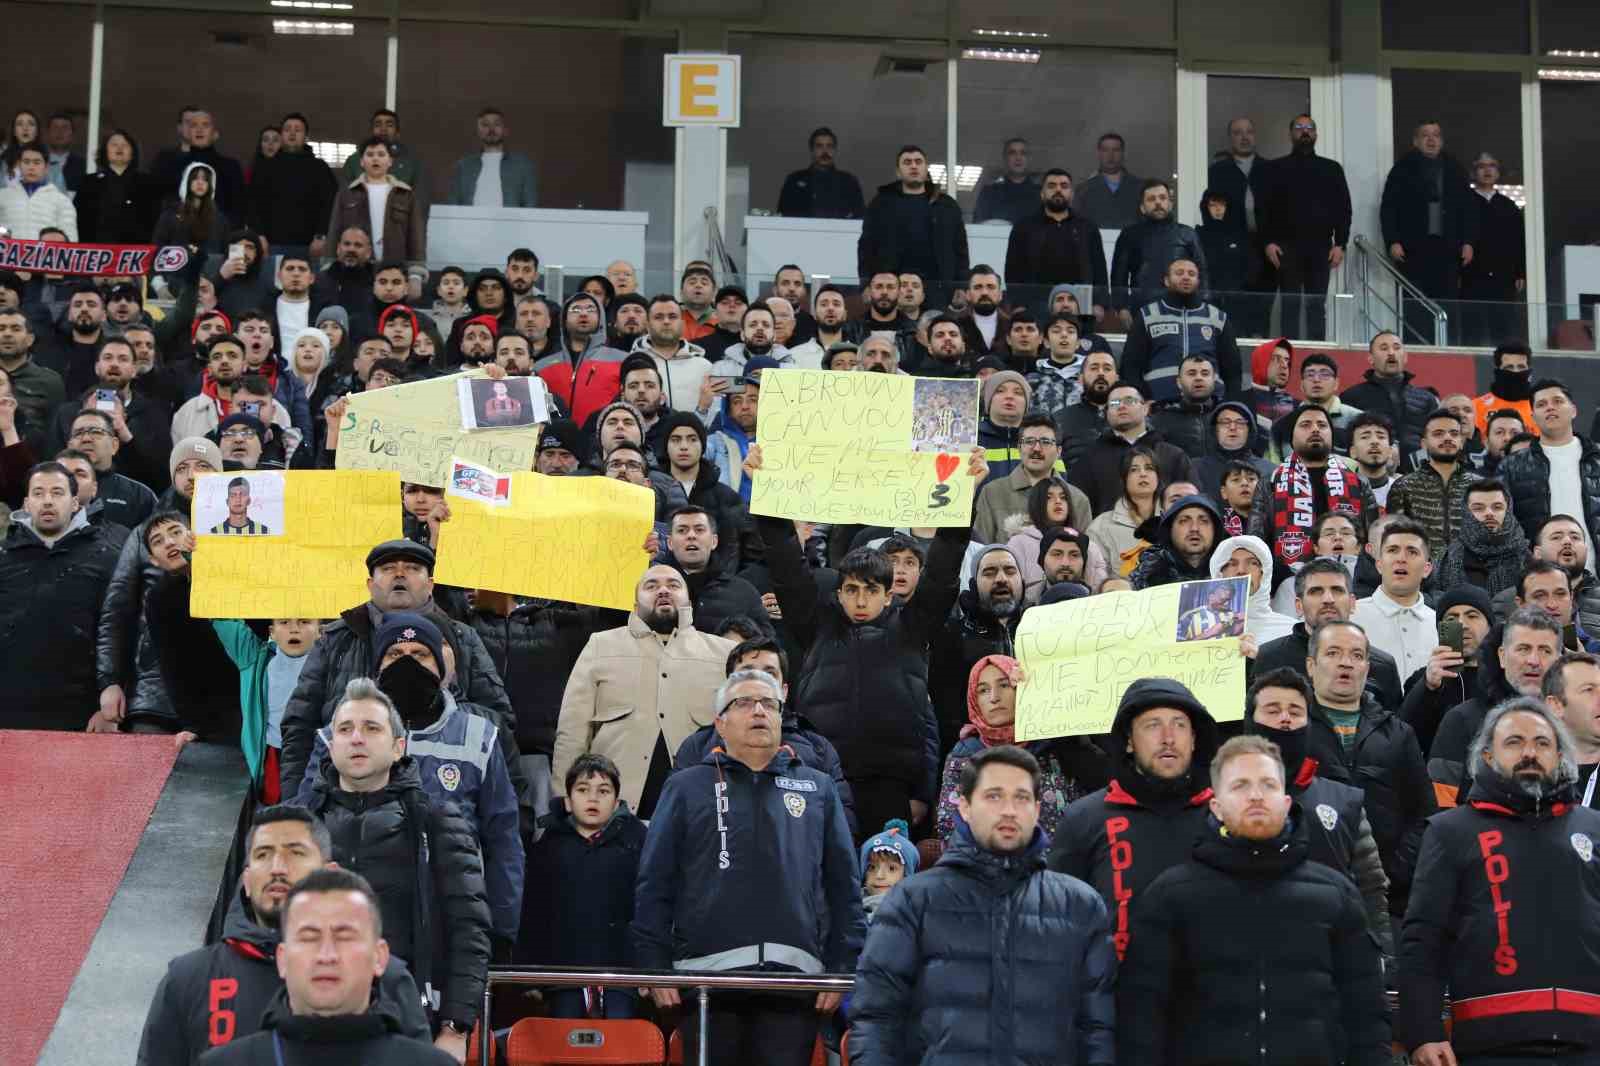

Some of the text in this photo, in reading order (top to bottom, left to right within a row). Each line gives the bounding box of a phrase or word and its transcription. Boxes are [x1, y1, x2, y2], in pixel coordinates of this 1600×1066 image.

[680, 63, 719, 116] E
[115, 248, 151, 273] FK
[760, 402, 905, 442] CAN YOU
[838, 437, 905, 466] ME
[1018, 613, 1168, 668] TU PEUX
[1019, 661, 1081, 705] ME
